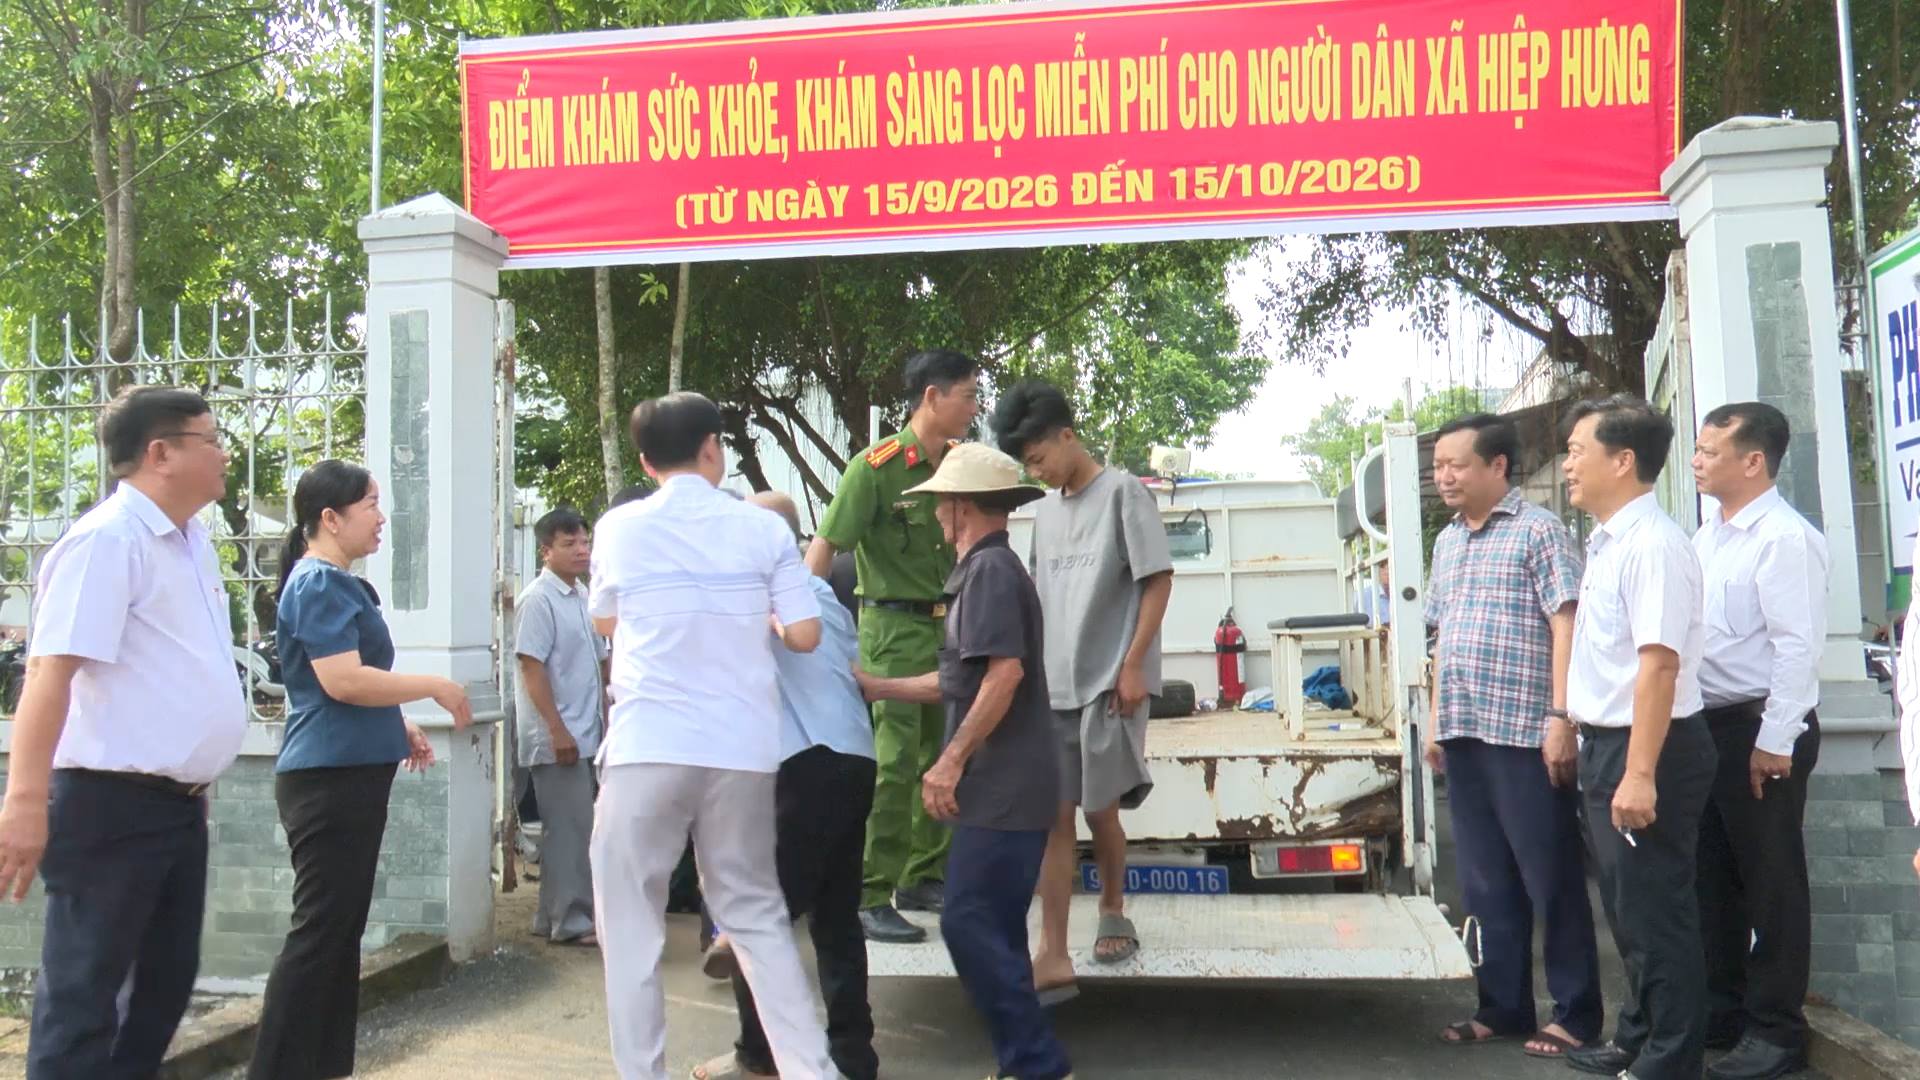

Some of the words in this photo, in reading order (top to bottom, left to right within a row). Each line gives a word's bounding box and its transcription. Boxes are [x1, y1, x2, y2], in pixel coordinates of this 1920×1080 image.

[488, 68, 555, 170] ĐIỂM
[562, 78, 639, 166] KHÁM
[648, 72, 701, 160] SỨC
[709, 57, 788, 161] KHỎE,
[796, 61, 877, 152] KHÁM
[886, 55, 963, 148] SÀNG
[972, 64, 1025, 158] LỌC
[1035, 32, 1110, 138] MIỄN
[1120, 38, 1168, 132] PHÍ
[1178, 50, 1237, 128] CHO
[1248, 23, 1341, 125] NGƯỜI
[1352, 25, 1415, 119] DÂN
[1426, 20, 1468, 115] XÃ
[1478, 15, 1550, 128] HIỆP
[1561, 17, 1650, 108] HƯNG
[676, 187, 738, 228] (TỪ
[747, 178, 848, 222] NGÀY
[863, 174, 1058, 217] 15/9/2026
[1071, 160, 1153, 205] ĐẾN
[1170, 156, 1420, 200] 15/10/2026)
